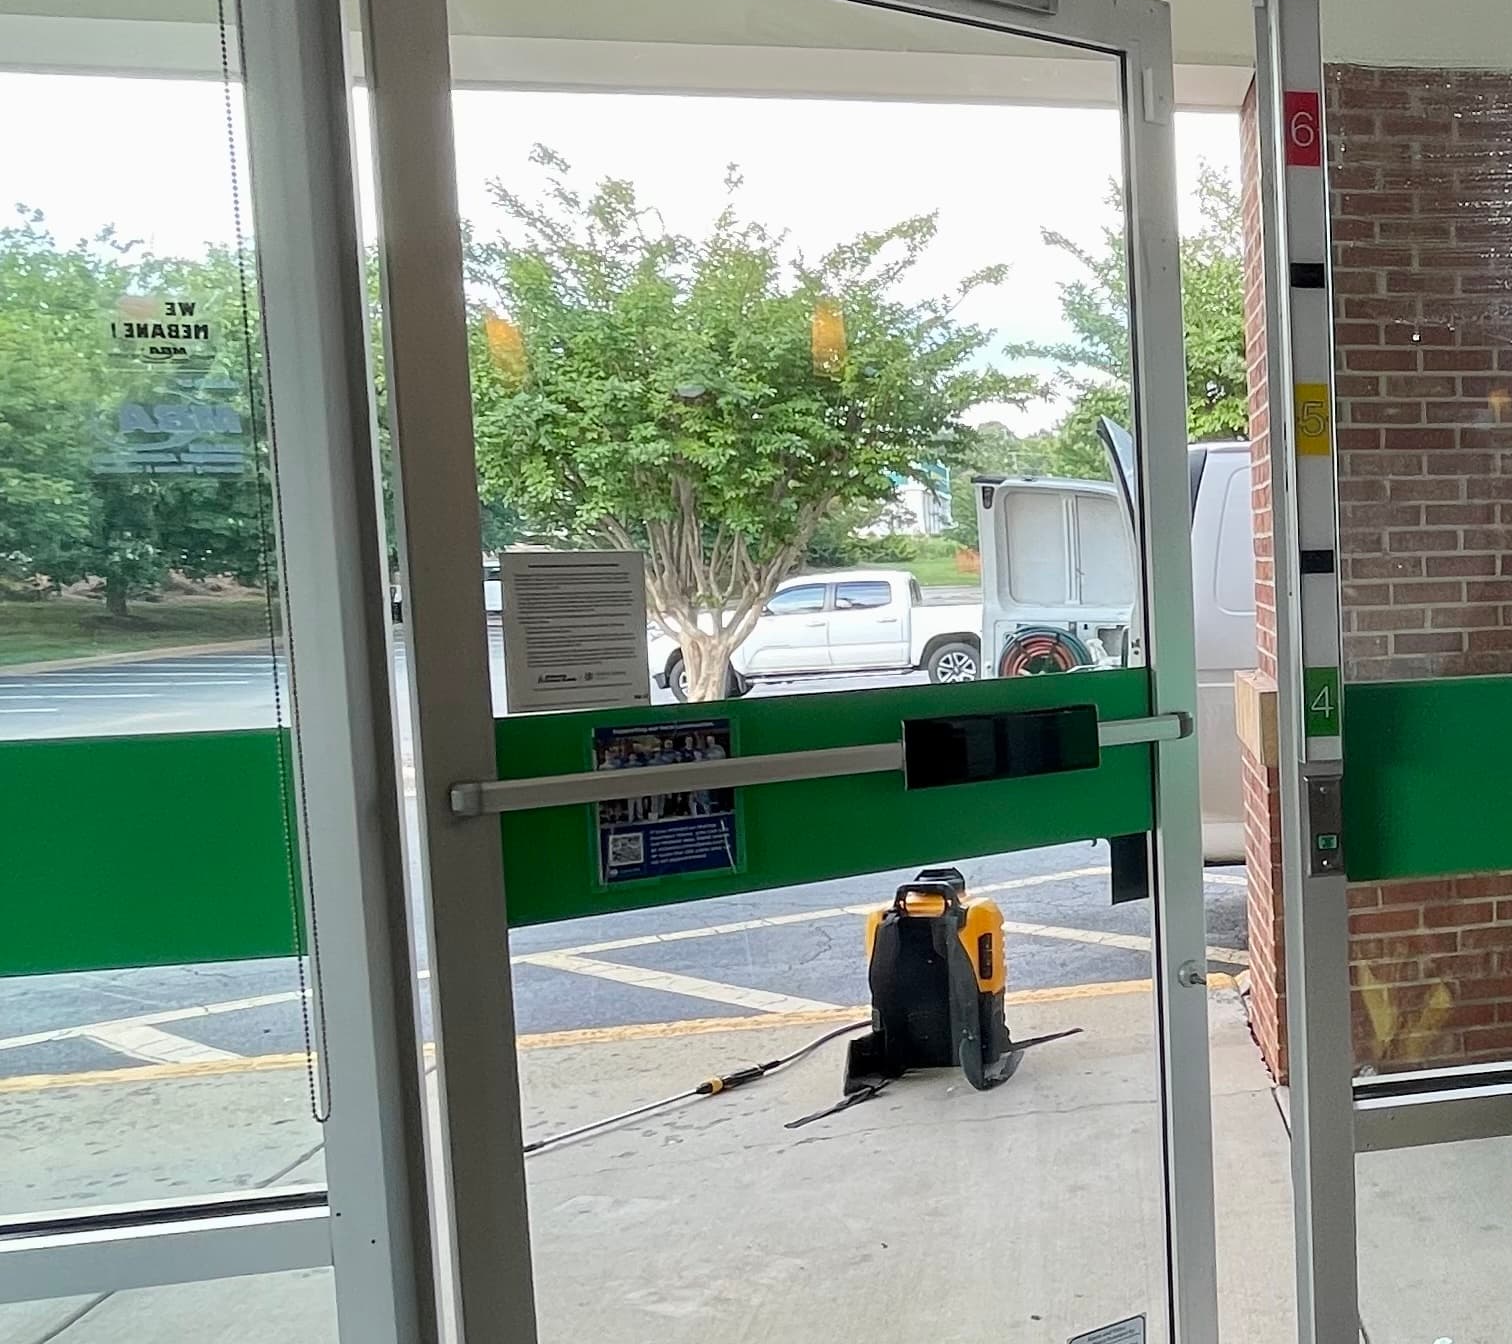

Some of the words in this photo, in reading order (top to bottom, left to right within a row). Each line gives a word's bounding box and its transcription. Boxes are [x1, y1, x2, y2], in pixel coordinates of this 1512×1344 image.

[1291, 111, 1314, 147] 6
[1301, 400, 1326, 438] 5
[1310, 685, 1335, 719] 4
